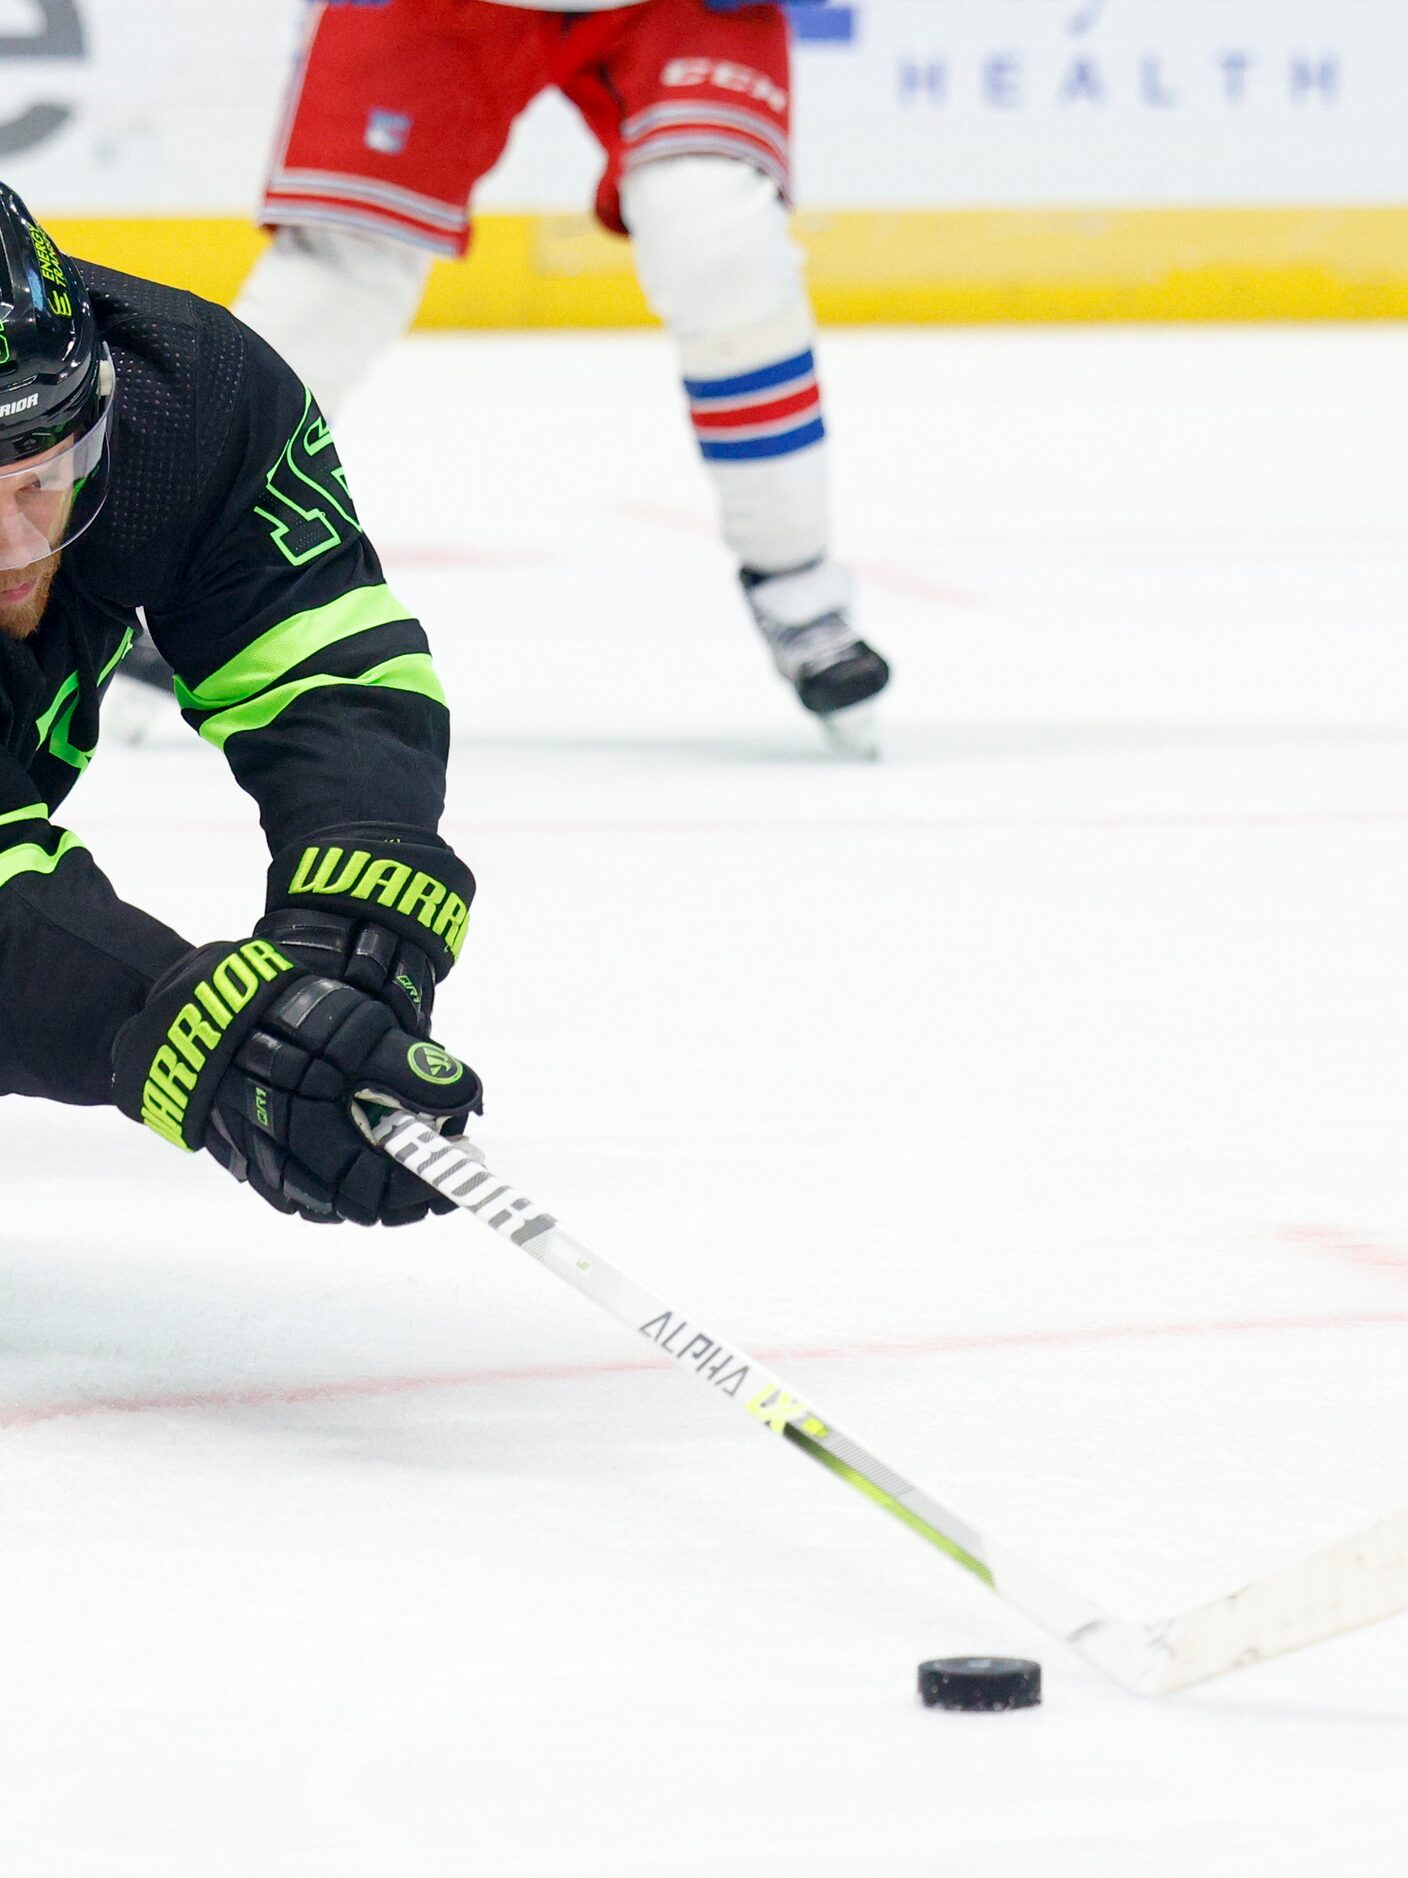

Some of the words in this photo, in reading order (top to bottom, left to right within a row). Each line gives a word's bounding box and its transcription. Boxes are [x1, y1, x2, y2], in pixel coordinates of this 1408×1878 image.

[900, 52, 1340, 111] HEALTH
[27, 221, 55, 282] ENERGY
[638, 1311, 750, 1398] ALPHA
